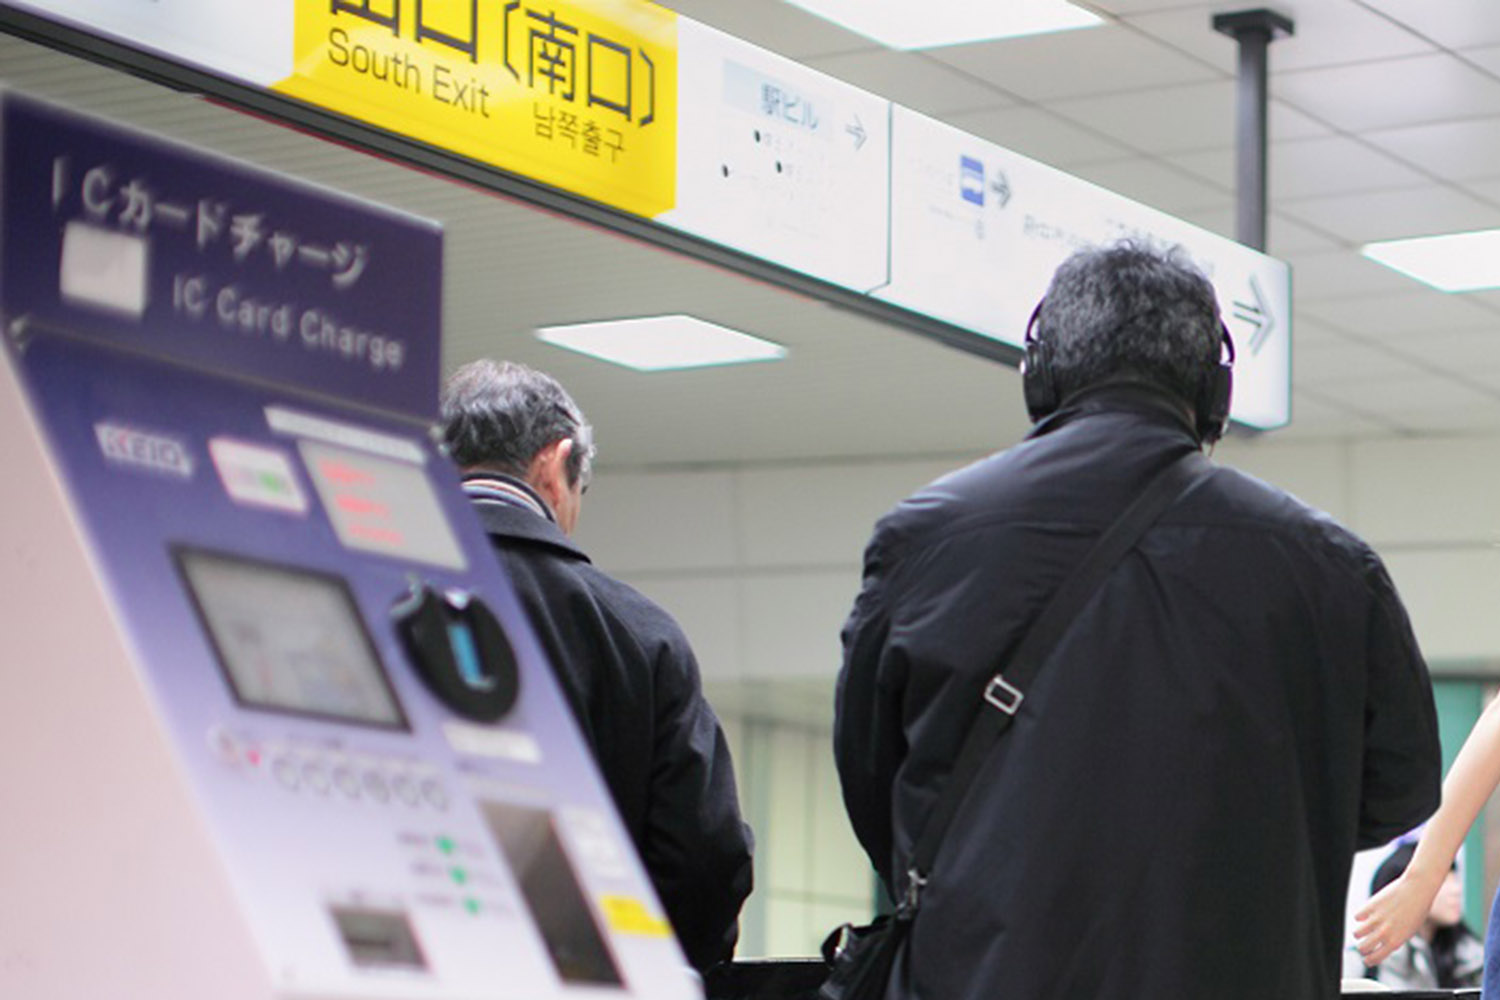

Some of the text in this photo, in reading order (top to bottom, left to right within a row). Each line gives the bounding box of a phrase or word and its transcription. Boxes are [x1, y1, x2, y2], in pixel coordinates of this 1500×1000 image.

[328, 27, 491, 119] South Exit
[532, 102, 625, 165] 남쪽출구
[171, 273, 407, 368] IC Card Charge
[101, 427, 184, 468] KEIO
